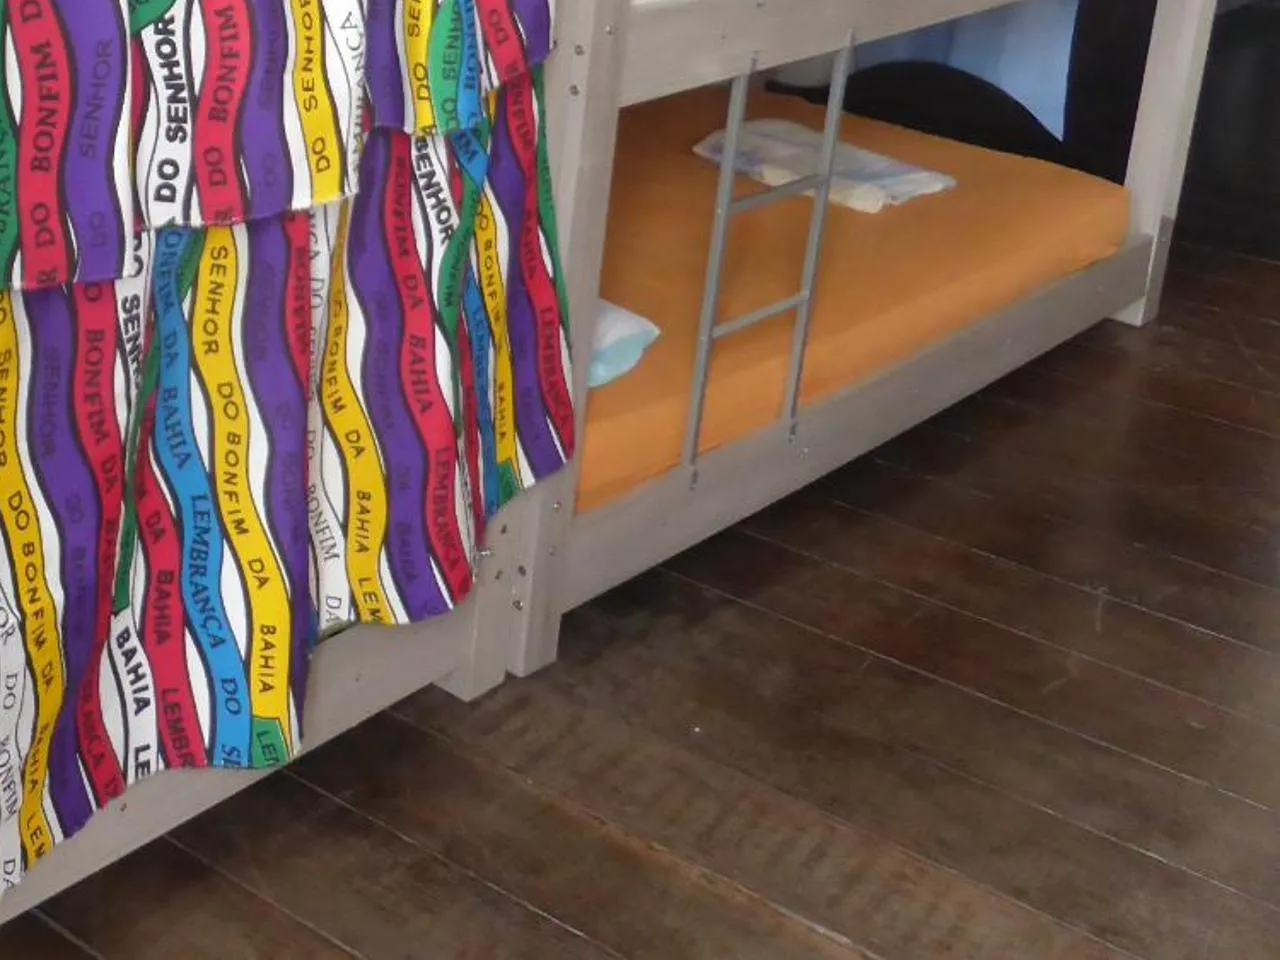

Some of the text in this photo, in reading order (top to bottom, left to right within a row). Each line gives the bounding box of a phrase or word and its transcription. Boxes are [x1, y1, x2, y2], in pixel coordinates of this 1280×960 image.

[208, 2, 239, 124] BONFIM
[412, 62, 428, 102] DO
[488, 8, 505, 45] DO
[30, 38, 60, 174] BONFIM
[80, 40, 111, 163] SENHOR
[152, 15, 187, 205] DO SENHOR
[311, 136, 331, 174] DO
[30, 203, 55, 248] DO
[202, 147, 227, 188] DO
[404, 274, 428, 413] DA BAHIA
[84, 330, 118, 495] BONFIM DA
[205, 245, 277, 694] SENHOR DO BONFIM DA BAHIA
[325, 327, 371, 553] BONFIM DA BAHIA
[145, 510, 172, 646] DA BAHIA
[162, 333, 242, 714] DA BAHIA LEMBRANÇA DO
[307, 483, 339, 562] BONFIM
[8, 490, 30, 533] DO
[22, 542, 44, 652] BONFIM
[42, 661, 53, 693] DA
[3, 673, 18, 712] DO
[116, 630, 150, 715] BAHIA
